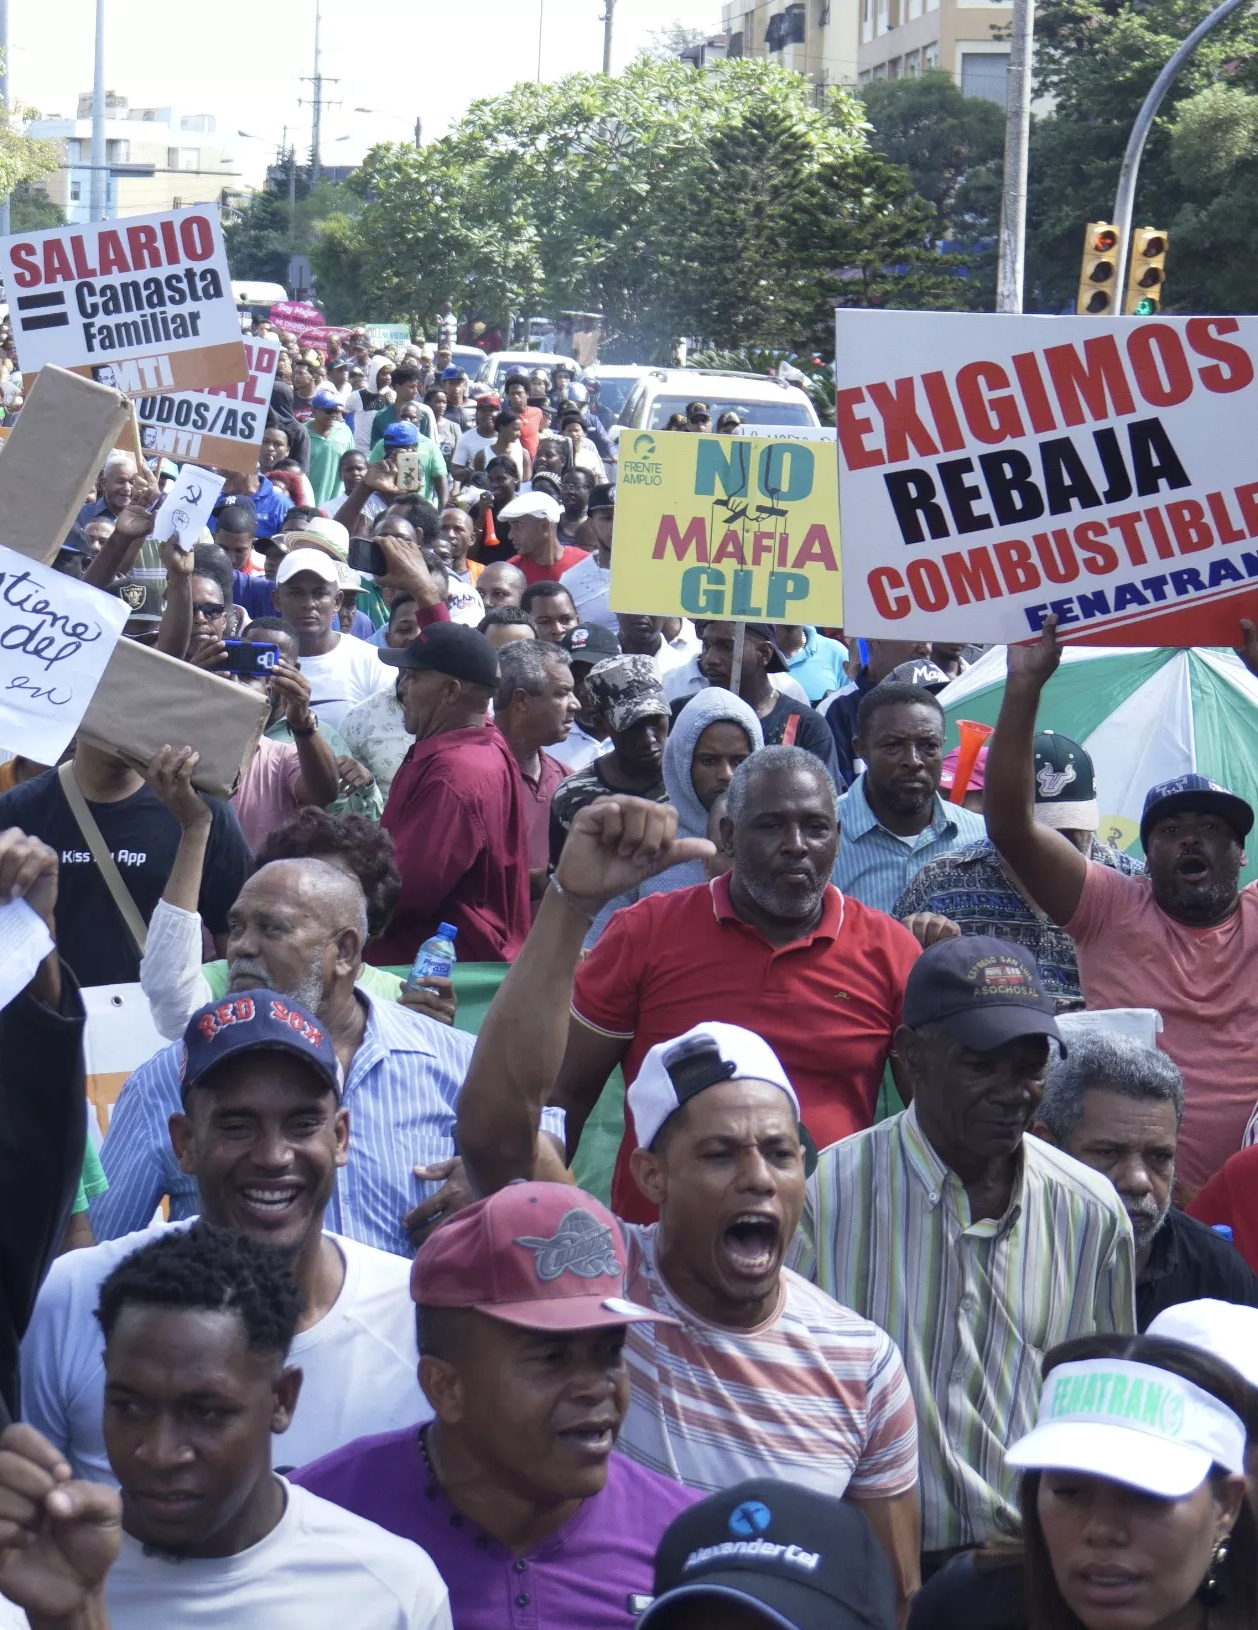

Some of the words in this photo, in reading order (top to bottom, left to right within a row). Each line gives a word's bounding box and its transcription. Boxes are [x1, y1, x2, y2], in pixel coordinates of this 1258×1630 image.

[10, 215, 215, 289] SALARIO
[75, 267, 224, 320] Canasta
[278, 303, 293, 315] Soy
[294, 307, 318, 318] Mujer
[83, 310, 201, 353] Familiar
[135, 396, 257, 440] ODOS/AS
[837, 317, 1254, 471] EXIGIMOS
[623, 474, 662, 486] AMPLIO
[624, 462, 662, 474] FRENTE
[694, 439, 815, 502] NO
[884, 417, 1192, 545] REBAJA
[652, 514, 839, 571] MAFIA
[680, 565, 810, 619] GLP
[0, 621, 82, 671] del
[62, 850, 91, 863] Kiss
[117, 849, 147, 867] App
[973, 985, 1039, 998] ASOCHOSAL
[198, 997, 256, 1043] RED
[270, 1000, 325, 1049] SOX
